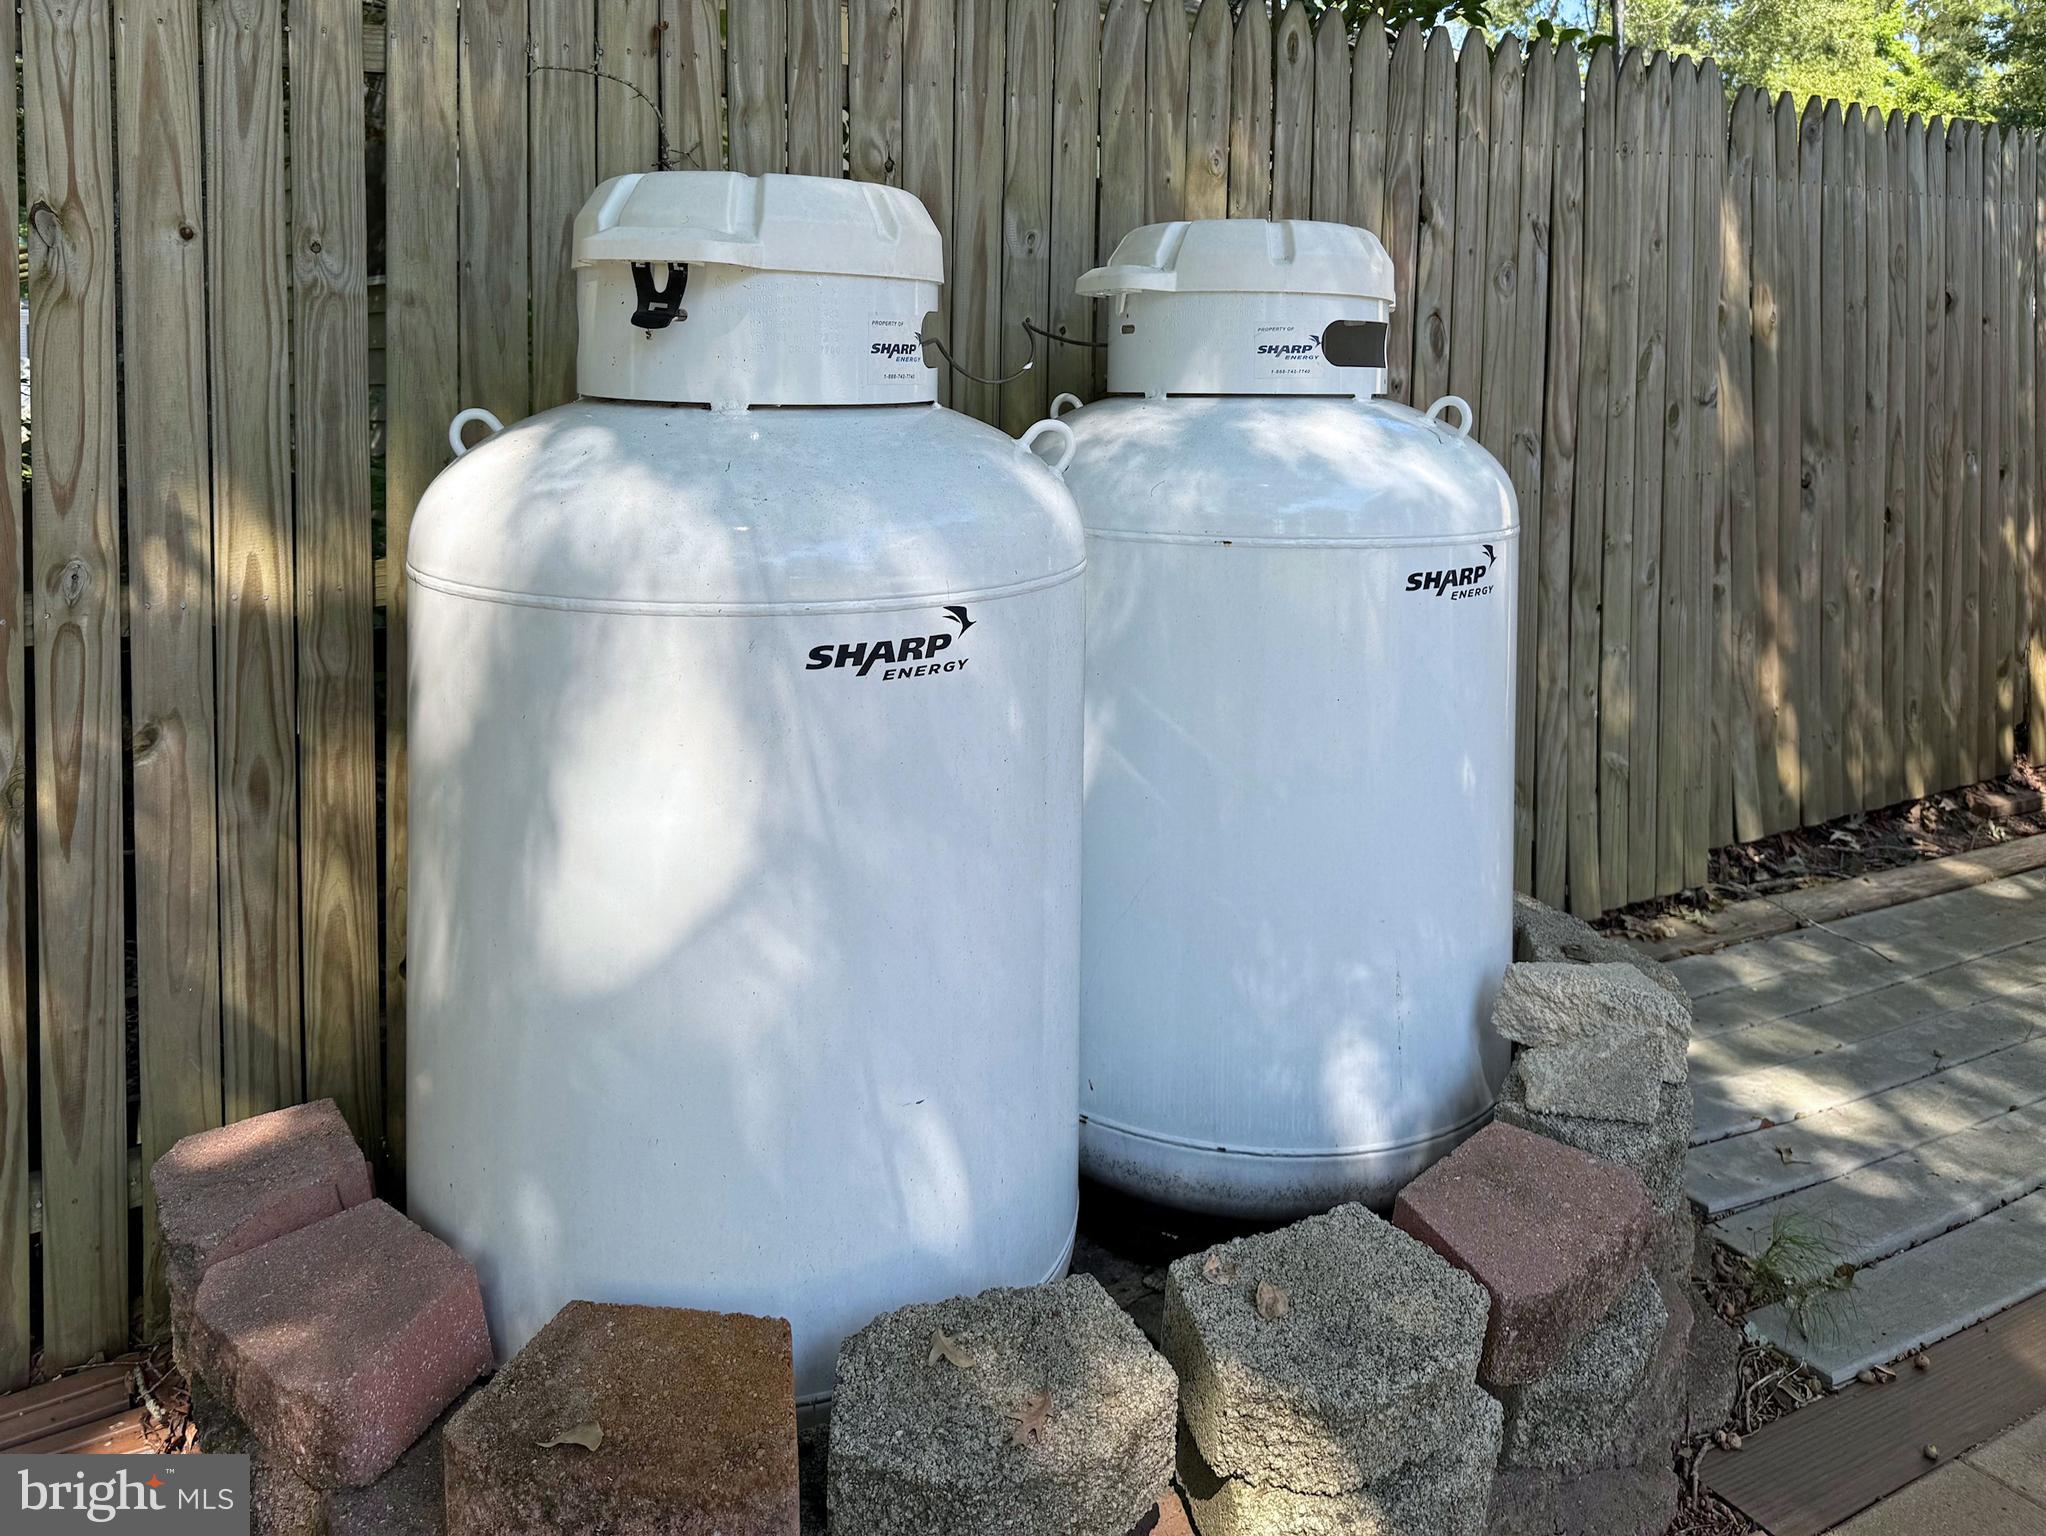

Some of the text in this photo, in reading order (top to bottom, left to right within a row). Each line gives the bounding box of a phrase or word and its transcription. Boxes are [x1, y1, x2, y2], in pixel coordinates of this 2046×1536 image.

[870, 343, 917, 359] SHARP
[1257, 345, 1313, 358] SHARP
[1405, 565, 1487, 597] SHARP
[1450, 585, 1494, 601] ENERGY
[805, 633, 952, 677] SHARP
[882, 658, 969, 682] ENERGY
